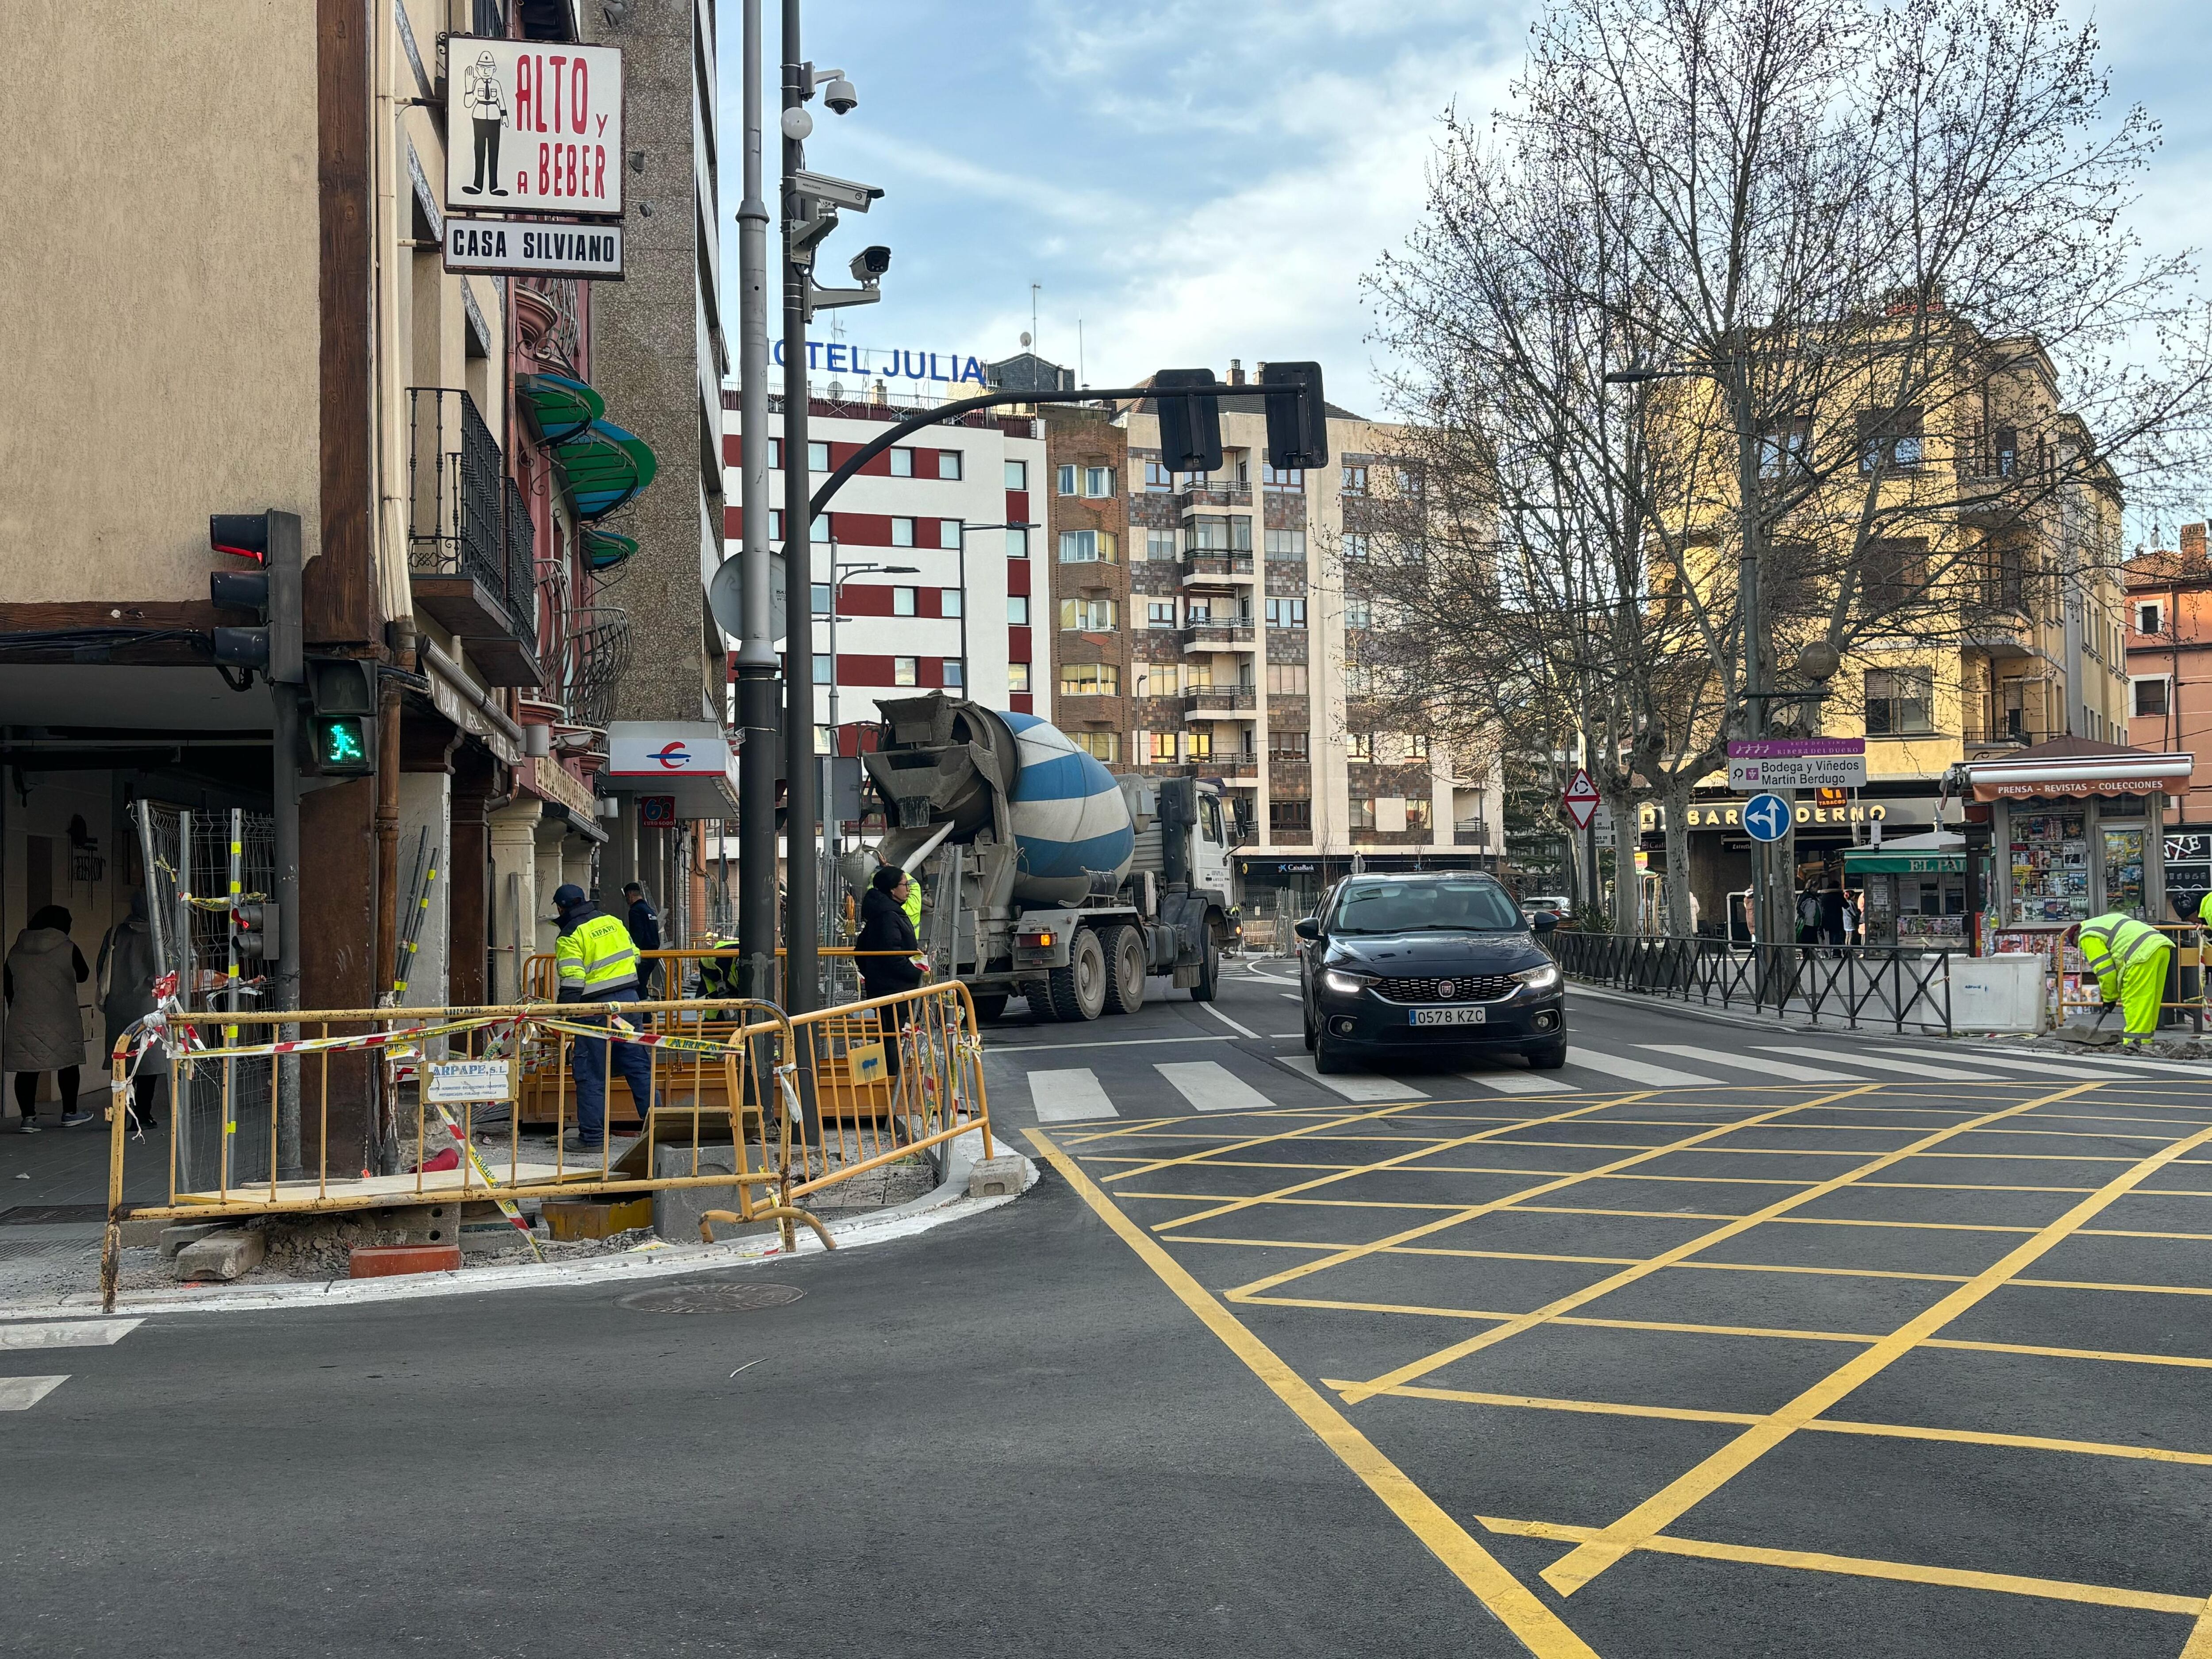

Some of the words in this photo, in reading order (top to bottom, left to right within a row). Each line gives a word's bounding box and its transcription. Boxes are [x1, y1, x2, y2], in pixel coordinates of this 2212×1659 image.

[515, 54, 588, 134] ALTO
[517, 171, 528, 194] A
[539, 142, 606, 199] BEBER
[453, 229, 507, 258] CASA
[523, 232, 614, 262] SILVIANO
[768, 338, 871, 375] TEL
[883, 349, 986, 385] JULIA
[1762, 762, 1803, 774] Bodega
[1806, 764, 1813, 774] y
[1816, 760, 1859, 771] Viñedos
[1762, 774, 1796, 785] Martín
[1800, 774, 1845, 785] Berdugo
[1998, 785, 2033, 794] PRENSA
[2044, 783, 2087, 792] REVISTAS
[2099, 780, 2163, 790] COLECCIONES
[1687, 809, 1738, 826] BAR
[1796, 805, 1886, 823] DERNO
[1909, 860, 1934, 872] EL
[1938, 859, 1966, 872] PAI
[1418, 1011, 1452, 1024] 0578
[1457, 1010, 1483, 1023] KZC
